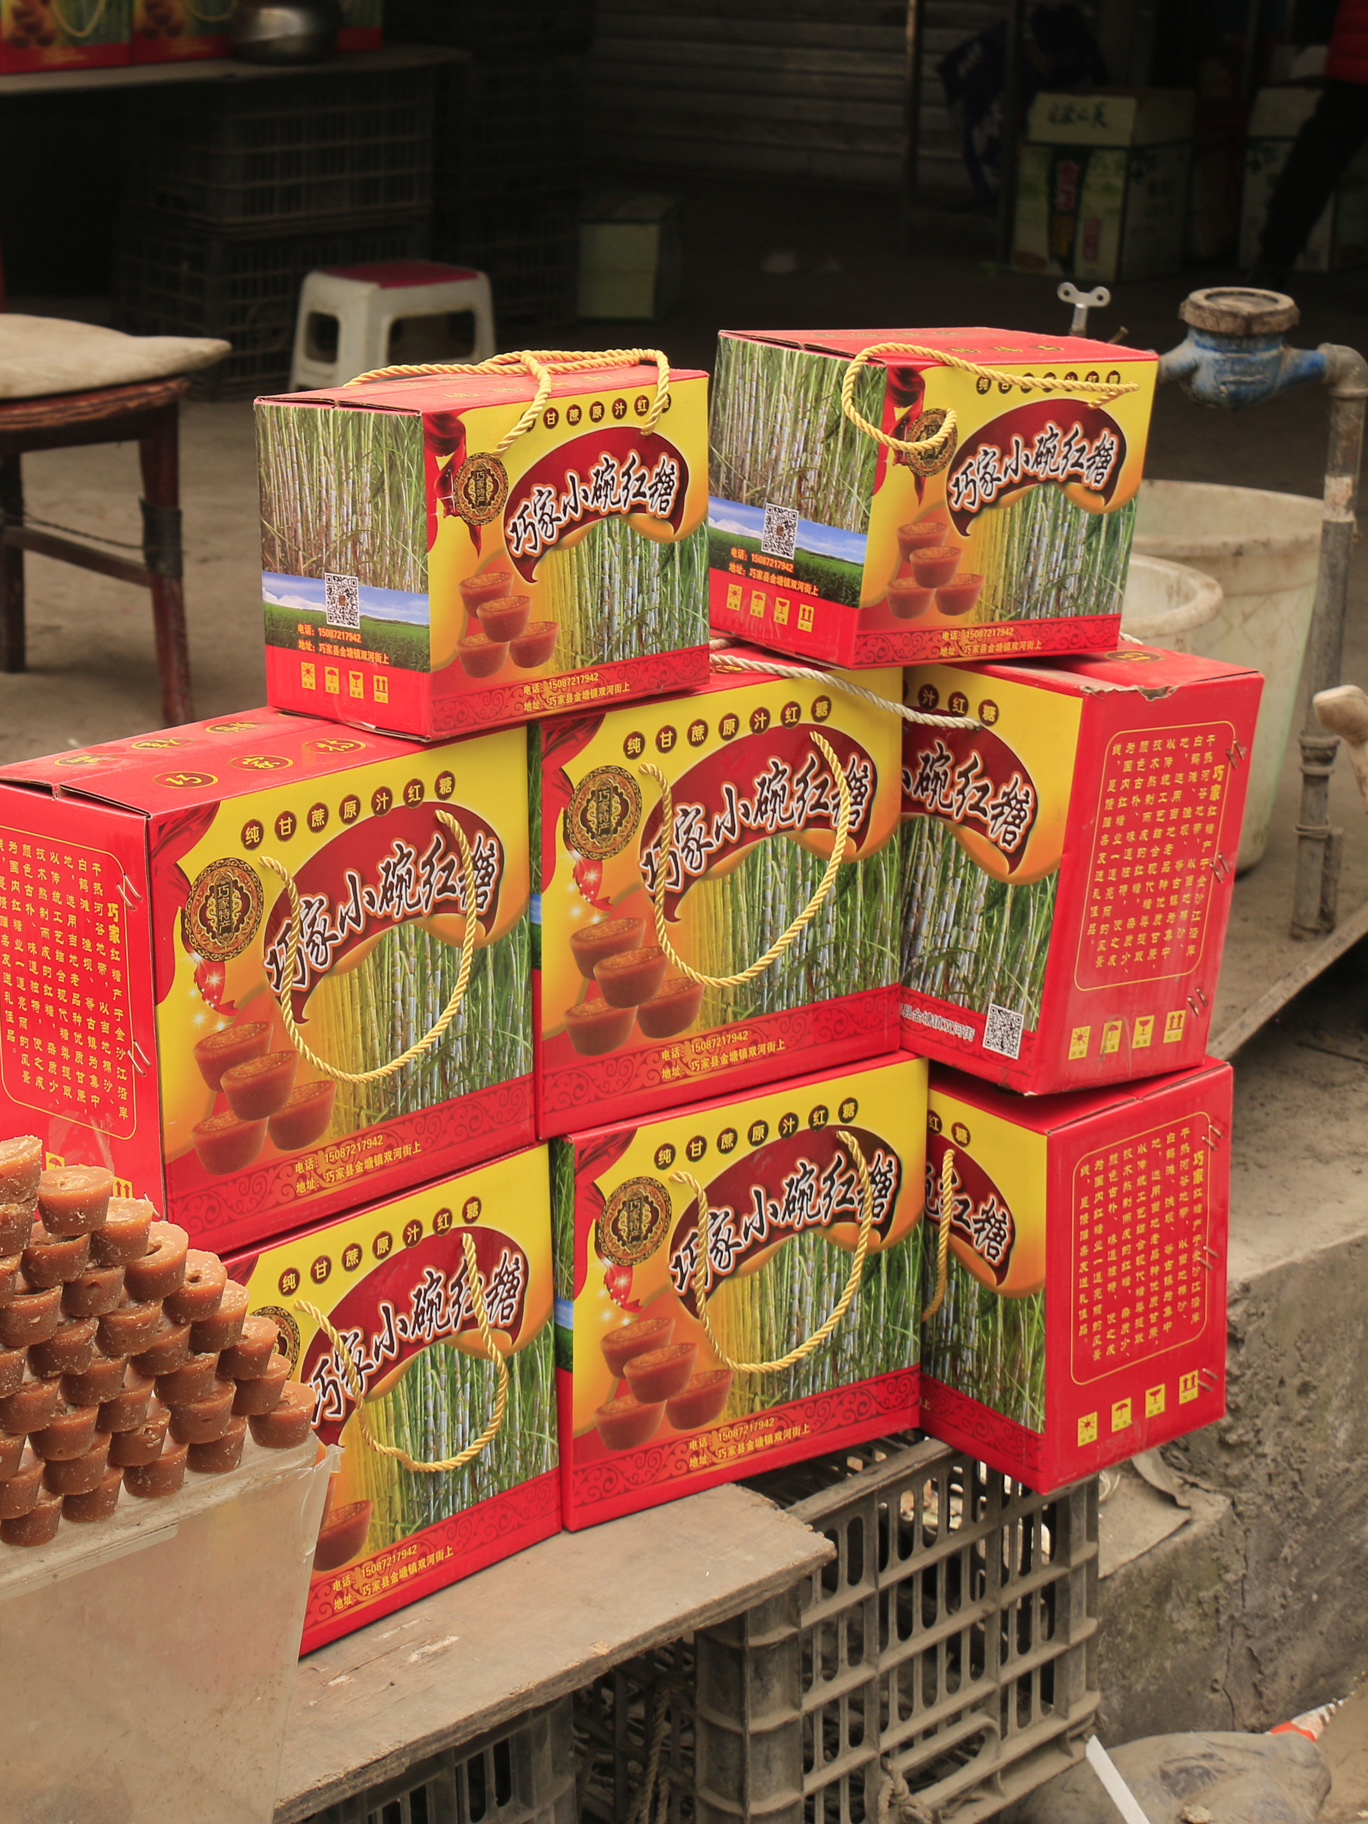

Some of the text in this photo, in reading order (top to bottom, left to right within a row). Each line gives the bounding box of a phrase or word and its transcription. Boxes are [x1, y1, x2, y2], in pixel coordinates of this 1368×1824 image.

[524, 396, 670, 429] 甘蔗原汁红
[949, 424, 1116, 508] 巧家小碗红糖
[507, 452, 679, 556] 巧家小碗红糖
[627, 701, 830, 755] 纯甘蔗原汁红糖
[244, 776, 454, 846] 纯甘蔗原汁红糖
[900, 1003, 976, 1042] 县金塘镇双河街
[658, 1102, 856, 1166] 纯甘蔗原汁红糖
[281, 1201, 480, 1292] 纯甘蔗原汁红糖
